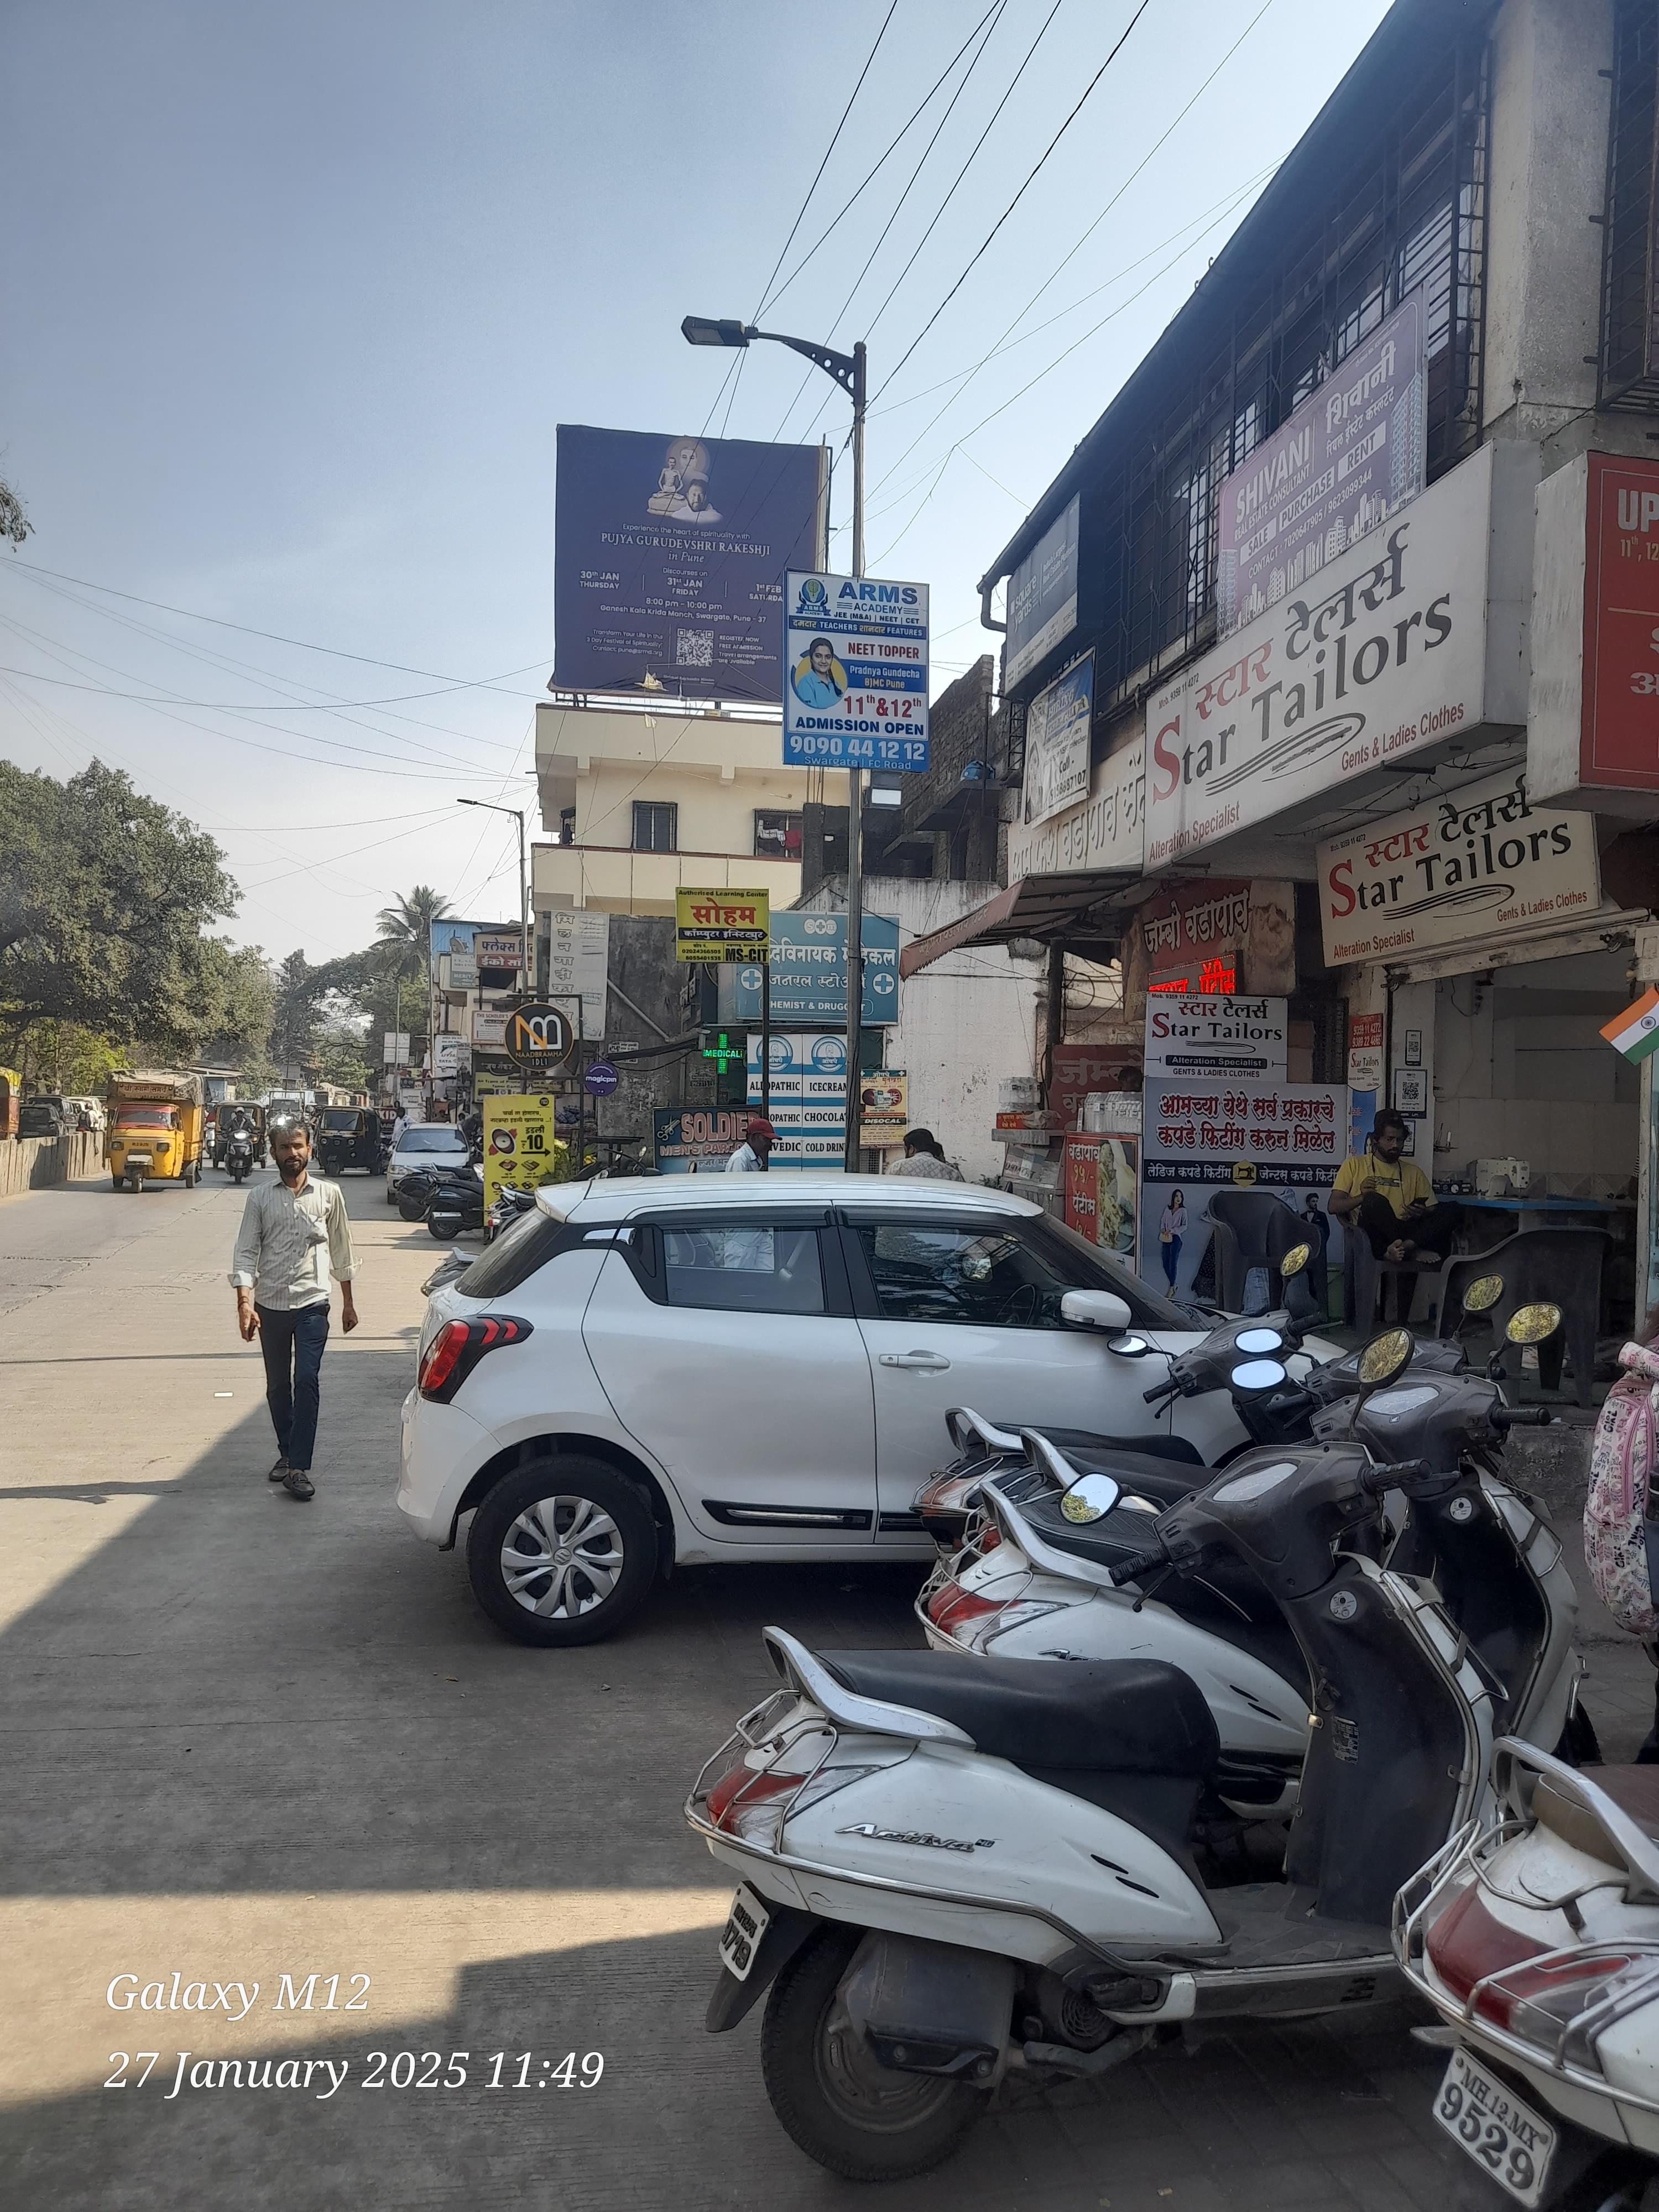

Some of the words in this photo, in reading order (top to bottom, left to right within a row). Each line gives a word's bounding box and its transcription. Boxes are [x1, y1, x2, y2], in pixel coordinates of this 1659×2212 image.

[1326, 340, 1397, 434] शिवानी
[1235, 424, 1313, 524] SHIVANI
[1248, 529, 1269, 557] SALE
[1282, 473, 1334, 529] PURCHASE
[1348, 432, 1376, 471] RENT
[601, 533, 633, 545] PUJYA
[637, 536, 716, 551] GURUDEVSHRI
[719, 542, 770, 557] RAKESHJI
[680, 552, 704, 562] Pune
[580, 570, 598, 580] 30th
[599, 571, 619, 581] JAN
[580, 581, 619, 589] THURSDAY
[684, 578, 703, 587] JAN
[672, 588, 699, 596] FRIDAY
[749, 593, 783, 602] SATURDA
[839, 582, 918, 604] ARMS
[1015, 575, 1036, 609] square
[1285, 522, 1410, 660] टेलर्स
[646, 597, 664, 606] 8:00
[687, 601, 707, 609] 10:00
[854, 602, 903, 615] ACADEMY
[792, 618, 817, 628] दमदार
[820, 620, 857, 632] TEACHERS
[859, 624, 885, 634] शानदार
[887, 627, 922, 637] FEATURES
[879, 614, 898, 623] NEET
[848, 642, 875, 656] NEET
[878, 644, 919, 659] TOPPER
[850, 665, 881, 677] Pradnya
[882, 667, 920, 679] Gundecha
[1196, 638, 1274, 721] स्टार
[886, 680, 905, 689] Pune
[1152, 714, 1235, 806] Star
[1251, 592, 1452, 741] Tailors
[796, 717, 879, 733] ADMISSION
[885, 722, 924, 735] OPEN
[1341, 749, 1369, 772] Gents
[1382, 723, 1416, 754] Ladies
[1420, 701, 1464, 737] Clothes
[790, 735, 843, 756] 9090
[848, 739, 874, 757] 44
[879, 740, 899, 759] 12
[904, 742, 925, 760] 12
[805, 755, 858, 769] Swargate
[869, 759, 880, 768] FC
[884, 760, 911, 770] Road
[1059, 756, 1070, 773] Call
[1364, 823, 1430, 868] स्टार
[1439, 774, 1533, 843] टेलर्स
[1149, 834, 1190, 863] Alteration
[1192, 800, 1240, 842] Specialist
[1328, 858, 1404, 919] Star
[1416, 822, 1572, 892] Tailors
[690, 898, 757, 927] सोहम
[1497, 907, 1519, 922] Gents
[1528, 899, 1554, 915] Ladies
[1556, 890, 1587, 909] Clothes
[1185, 888, 1249, 946] वडापाव
[1334, 940, 1371, 959] Alteration
[1373, 927, 1415, 950] Specialist
[726, 948, 768, 962] MS-CIT
[1178, 1001, 1218, 1016] स्टार
[1222, 997, 1269, 1019] टेलर्स
[1152, 1012, 1200, 1039] Star
[1208, 1022, 1282, 1041] Tailors
[1172, 1056, 1215, 1065] Alteration
[1218, 1058, 1261, 1067] Specialist
[586, 1074, 617, 1083] magicpin
[1160, 1092, 1219, 1117] आमच्या
[1222, 1091, 1248, 1118] येथे
[1252, 1092, 1279, 1120] सर्व
[1281, 1094, 1335, 1122] प्रकारचे
[525, 1125, 545, 1134] इडली
[1157, 1120, 1196, 1147] कपडे
[1292, 1124, 1335, 1152] मिळेल
[659, 1144, 701, 1156] MEN'S
[703, 1142, 744, 1155] PARLO
[806, 1143, 825, 1152] COLD
[826, 1143, 846, 1152] DRIN
[1068, 1144, 1100, 1162] वडापाव
[1147, 1163, 1175, 1178] लेडिज
[1178, 1164, 1201, 1178] कपडे
[1291, 1167, 1313, 1181] कपडे
[1316, 1168, 1338, 1182] फिटीं
[836, 1823, 974, 1853] Activa
[1440, 2081, 1535, 2190] 9529
